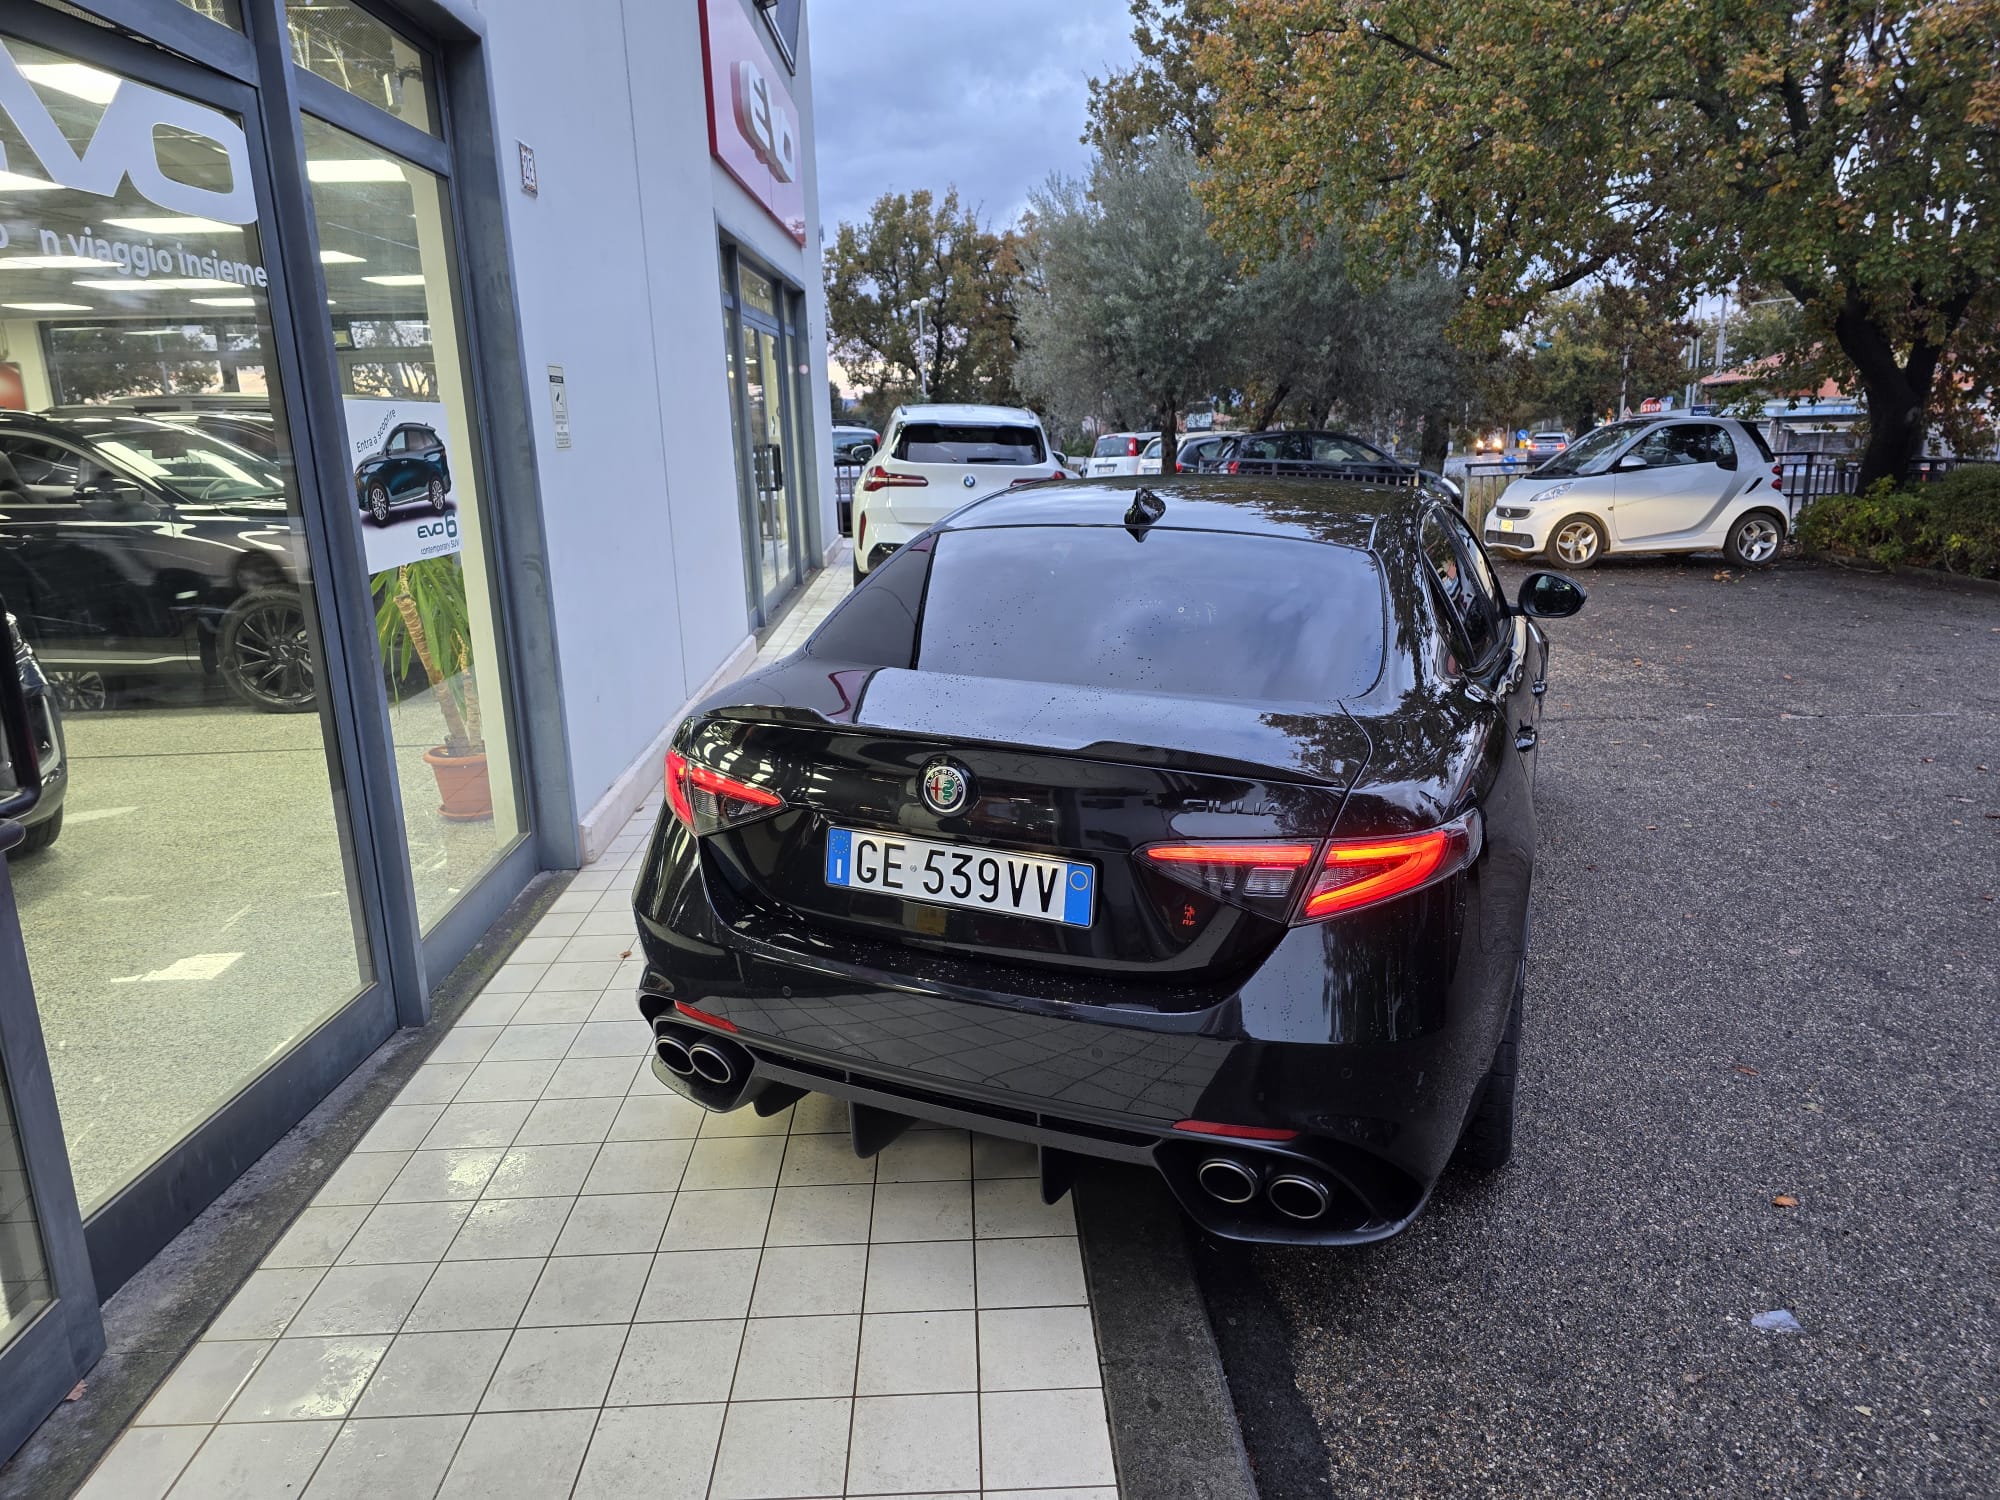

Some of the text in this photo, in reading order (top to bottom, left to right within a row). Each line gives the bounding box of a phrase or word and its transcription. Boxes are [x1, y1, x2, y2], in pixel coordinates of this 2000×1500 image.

[0, 38, 258, 225] VO
[67, 226, 172, 278] viaggio
[176, 242, 268, 288] insieme
[1642, 404, 1661, 412] STOP
[356, 439, 373, 453] Entra
[856, 839, 906, 890] GE
[922, 849, 1058, 913] 539VV
